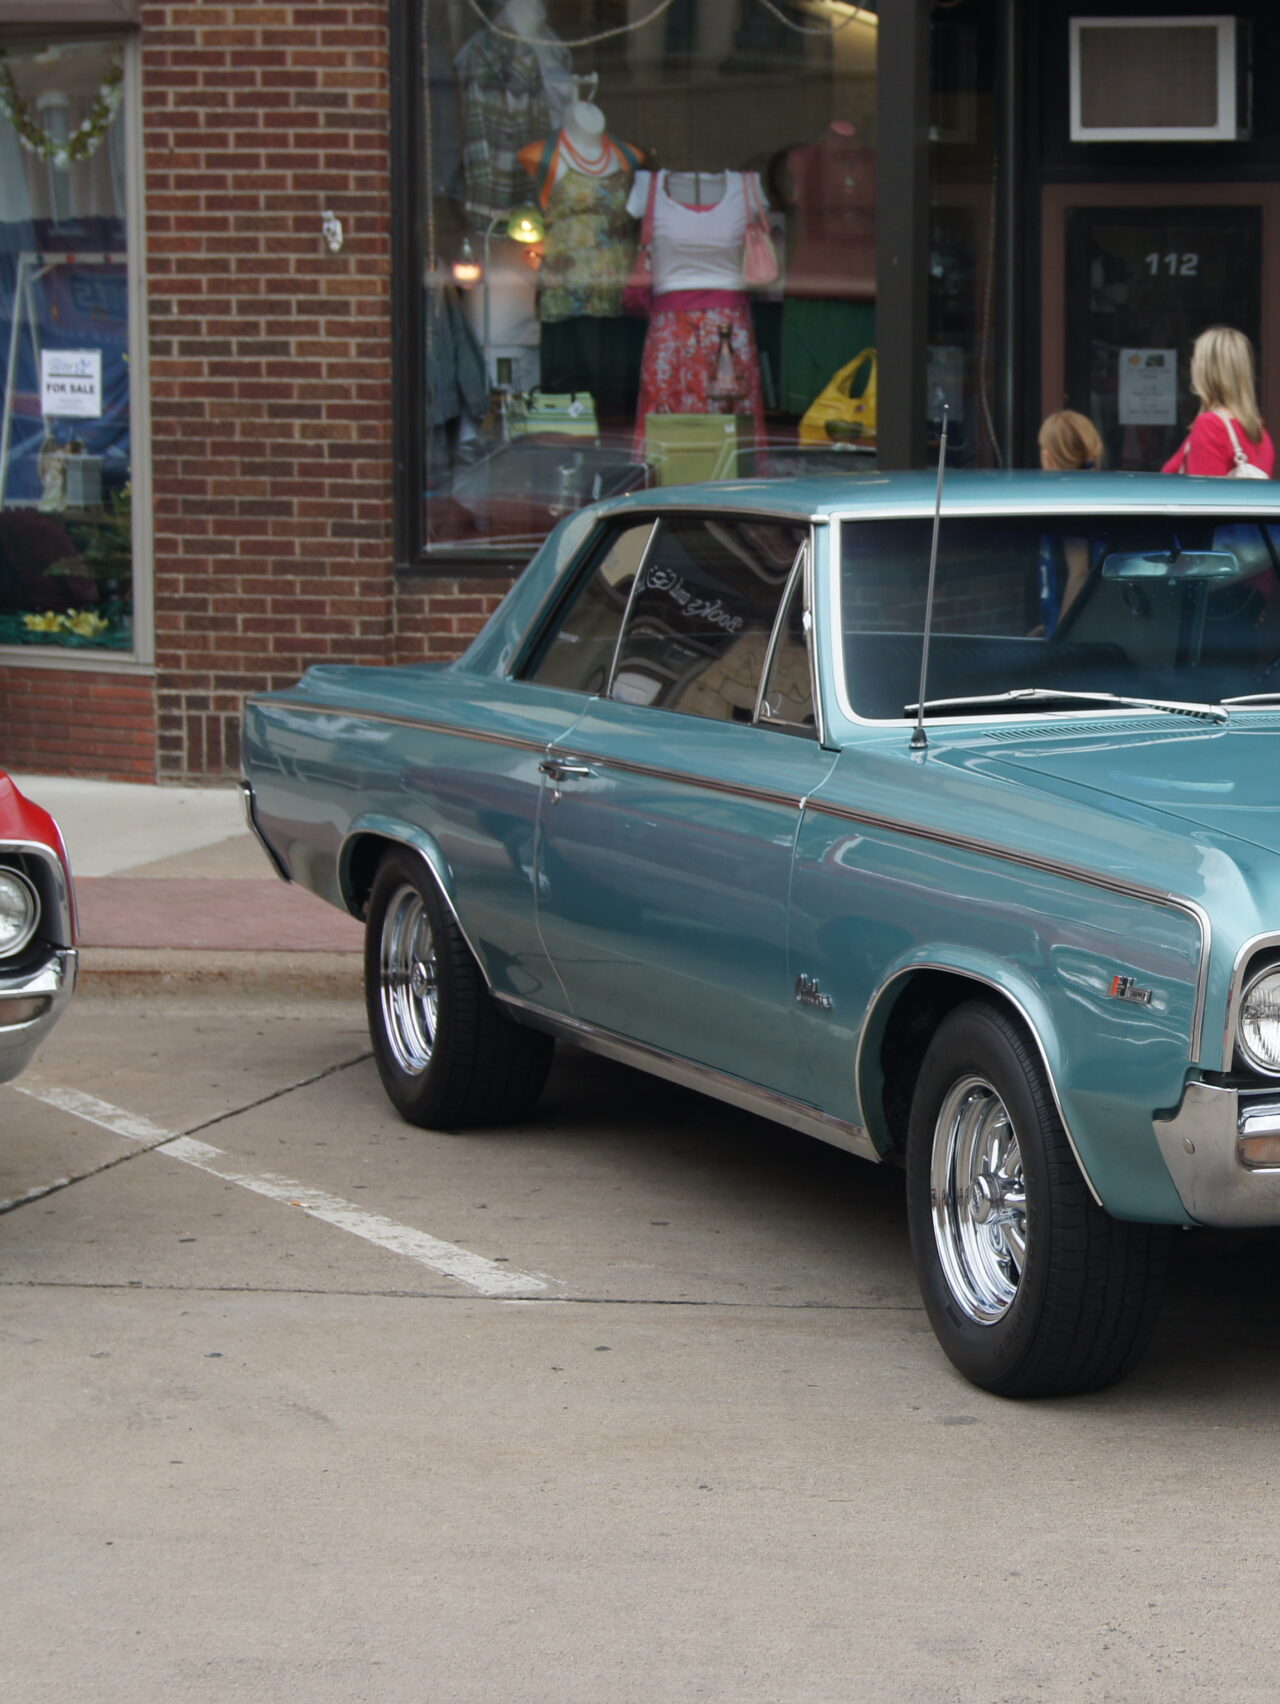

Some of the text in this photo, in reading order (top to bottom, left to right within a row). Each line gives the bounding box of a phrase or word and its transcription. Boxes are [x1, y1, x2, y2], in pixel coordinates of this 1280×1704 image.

[1145, 253, 1199, 276] 112
[47, 384, 94, 394] FOR SALE
